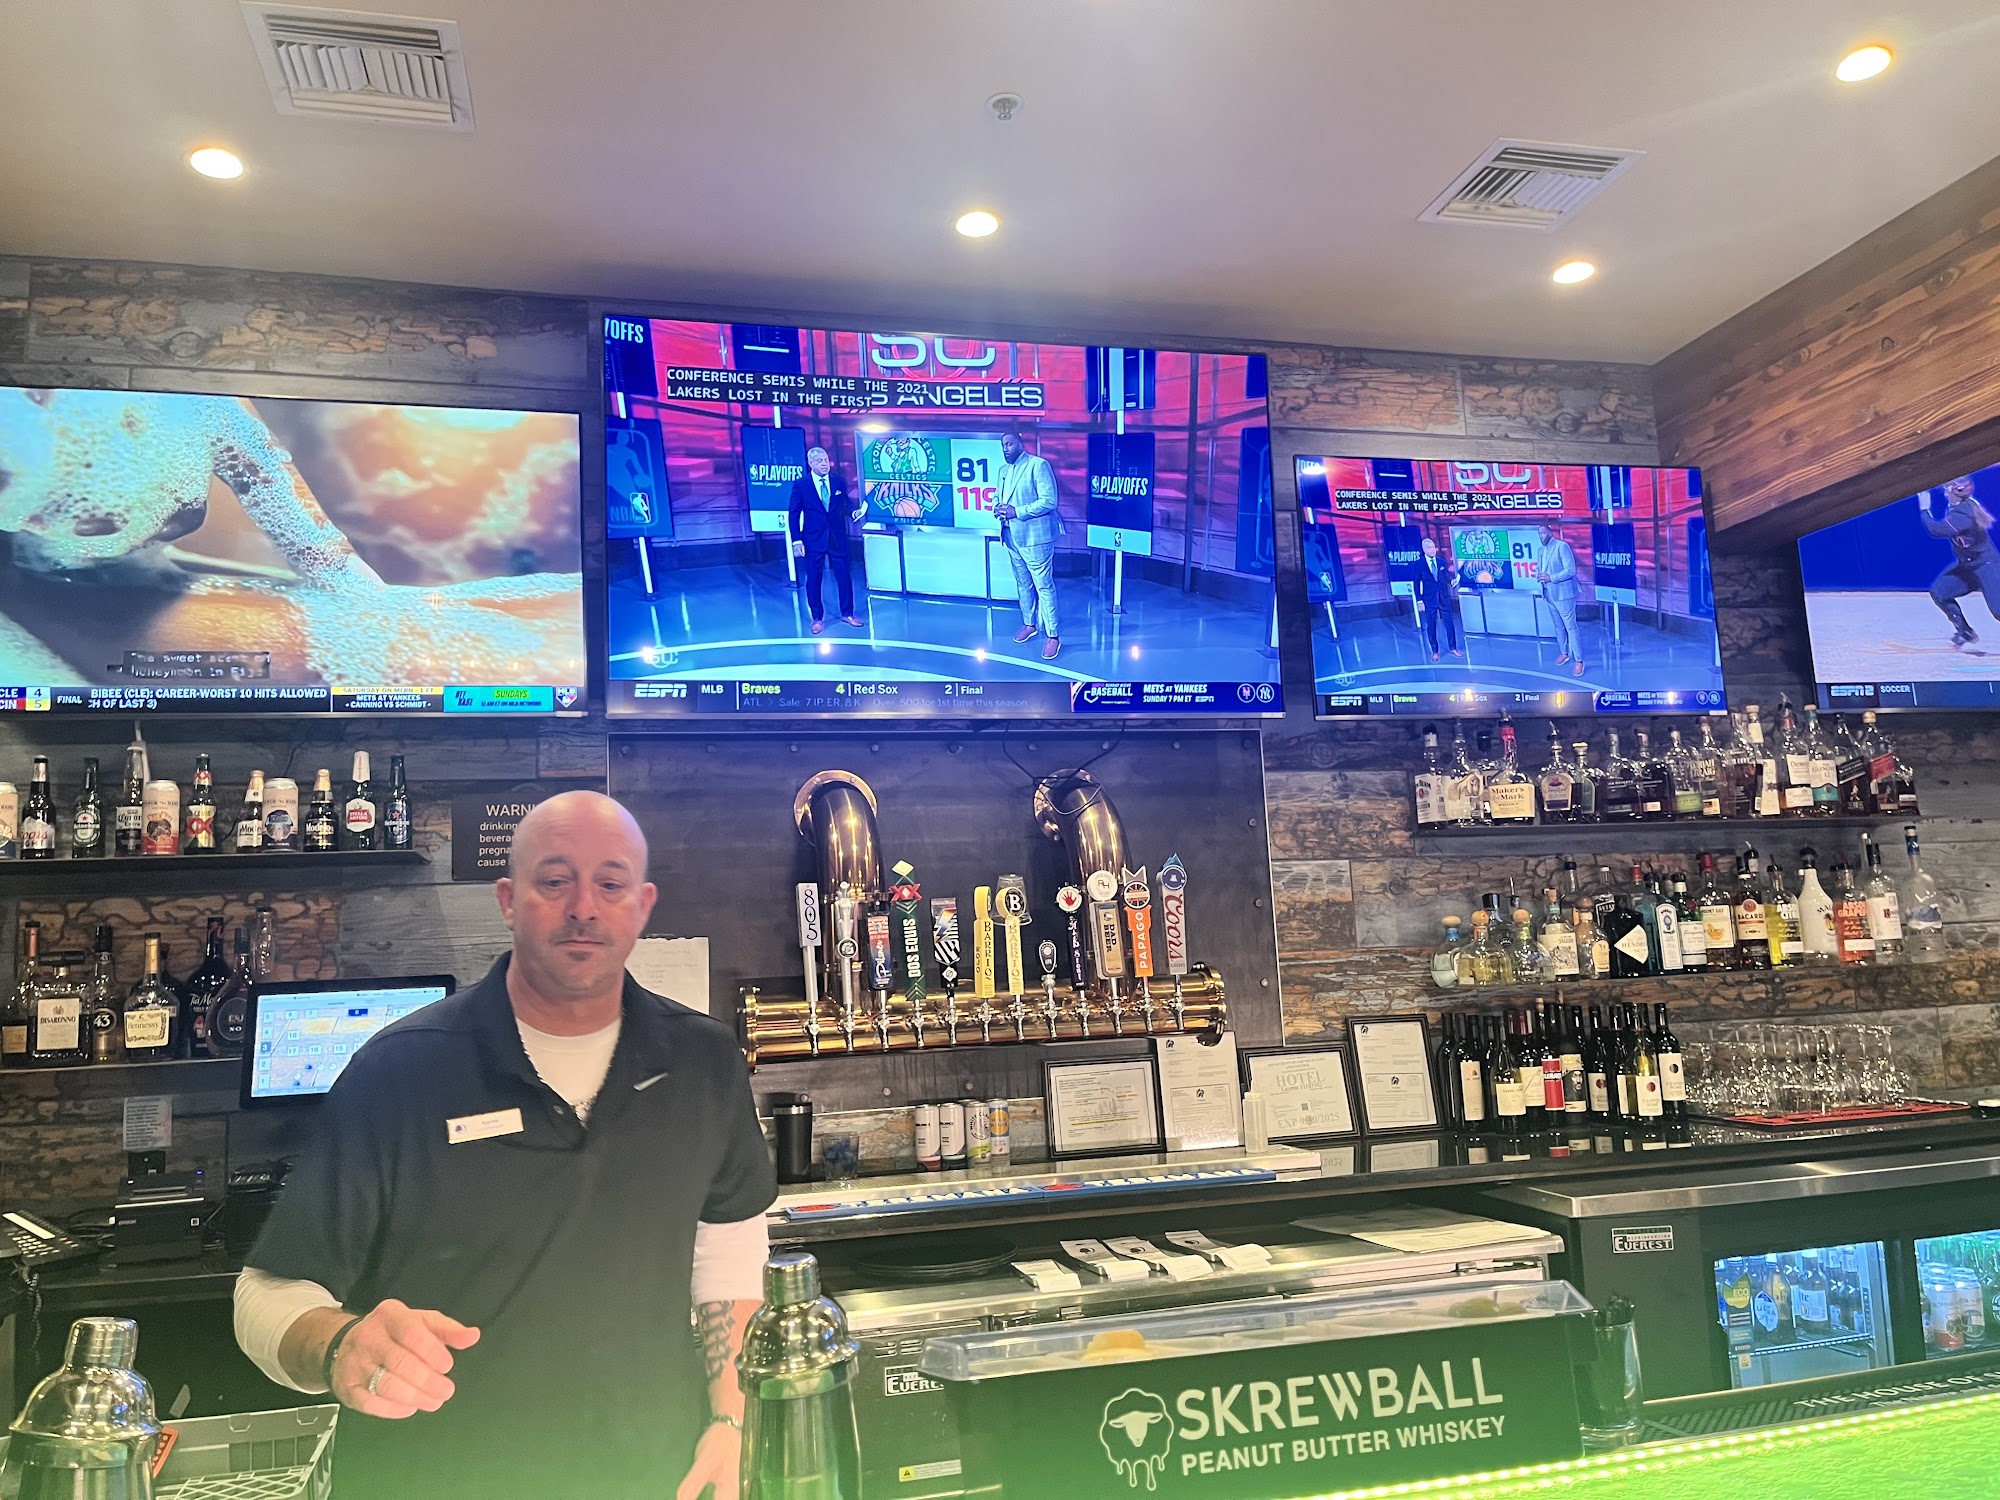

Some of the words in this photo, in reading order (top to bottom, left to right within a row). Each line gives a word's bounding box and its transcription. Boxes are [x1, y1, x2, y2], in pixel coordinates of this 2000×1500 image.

[667, 368, 754, 385] CONFERENCE
[763, 376, 805, 387] SEMIS
[813, 377, 856, 390] WHILE
[864, 381, 888, 392] THE
[897, 383, 929, 394] 2021
[667, 386, 720, 399] LAKERS
[728, 389, 763, 402] LOST
[772, 392, 788, 403] IN
[797, 393, 822, 405] THE
[831, 395, 872, 407] FIRST
[758, 464, 803, 482] PLAYOFFS
[957, 457, 989, 483] 81
[889, 473, 927, 481] CELTICS
[1100, 475, 1149, 496] PLAYOFFS
[957, 486, 997, 511] 119
[1335, 490, 1388, 500] CONFERENCE
[1391, 491, 1418, 501] SEMIS
[1421, 493, 1448, 501] WHILE
[1452, 493, 1468, 502] THE
[1472, 493, 1492, 502] 2021
[1336, 501, 1368, 510] LAKERS
[1372, 502, 1393, 511] LOST
[1398, 503, 1409, 511] IN
[1416, 503, 1429, 512] THE
[1433, 504, 1458, 512] FIRST
[1512, 542, 1533, 560] 81
[1601, 552, 1631, 567] PLAYOFFS
[1514, 561, 1538, 579] 119
[0, 688, 18, 699] CLE
[35, 688, 43, 699] 4
[91, 688, 122, 699] BIBEE
[124, 688, 153, 700] (CLE):
[155, 689, 237, 699] CAREER-WORST
[240, 689, 252, 699] 10
[254, 689, 277, 699] HITS
[279, 688, 327, 699] ALLOWED
[495, 690, 529, 699] SUNDAYS
[634, 683, 687, 698] ESPN
[701, 684, 724, 694] MLB
[741, 683, 782, 694] Braves
[835, 684, 845, 694] 4
[854, 684, 876, 694] Red
[877, 684, 899, 694] Sox
[944, 685, 953, 695] 2
[961, 686, 983, 695] Final
[1091, 686, 1133, 697] BASEBALL
[1143, 684, 1165, 694] METS
[1174, 684, 1208, 694] YANKEES
[1880, 685, 1911, 693] SOCCER
[35, 700, 42, 710] 5
[57, 694, 82, 704] FINAL
[103, 700, 117, 709] OF
[119, 700, 145, 709] LAST
[147, 700, 157, 710] 3)
[384, 701, 394, 709] VS
[743, 698, 762, 706] ATL
[779, 698, 801, 706] Sale
[953, 698, 974, 706] time
[976, 698, 994, 706] this
[995, 699, 1028, 707] season
[1143, 695, 1168, 703] SUNDAY
[1330, 695, 1362, 707] ESPN
[1393, 695, 1418, 703] Braves
[1491, 786, 1525, 794] Maker's
[477, 858, 506, 867] cause
[888, 883, 923, 904] XX
[1009, 893, 1021, 911] B
[804, 888, 818, 941] 805
[1164, 893, 1184, 962] Coors
[903, 918, 920, 953] EQUIS
[1103, 924, 1112, 953] BEER
[1109, 923, 1117, 946] DAD
[1135, 911, 1149, 969] PAPAGO
[984, 921, 993, 980] BARRIO
[1009, 924, 1020, 980] BARRIO
[906, 953, 921, 978] DOS
[40, 1016, 76, 1025] DISARONNO
[93, 1014, 111, 1027] 43
[128, 1020, 159, 1031] Hennessy
[1276, 1070, 1327, 1088] HOTEL
[1277, 1118, 1298, 1130] EXP
[1732, 1288, 1749, 1296] ECO
[1794, 1393, 1855, 1409] THE
[1851, 1381, 1950, 1400] HOUSE
[1947, 1374, 1984, 1386] OF
[1176, 1357, 1504, 1441] SKREWBALL
[1182, 1442, 1285, 1476] PEANUT
[1292, 1429, 1391, 1462] BUTTER
[1398, 1415, 1506, 1449] WHISKEY
